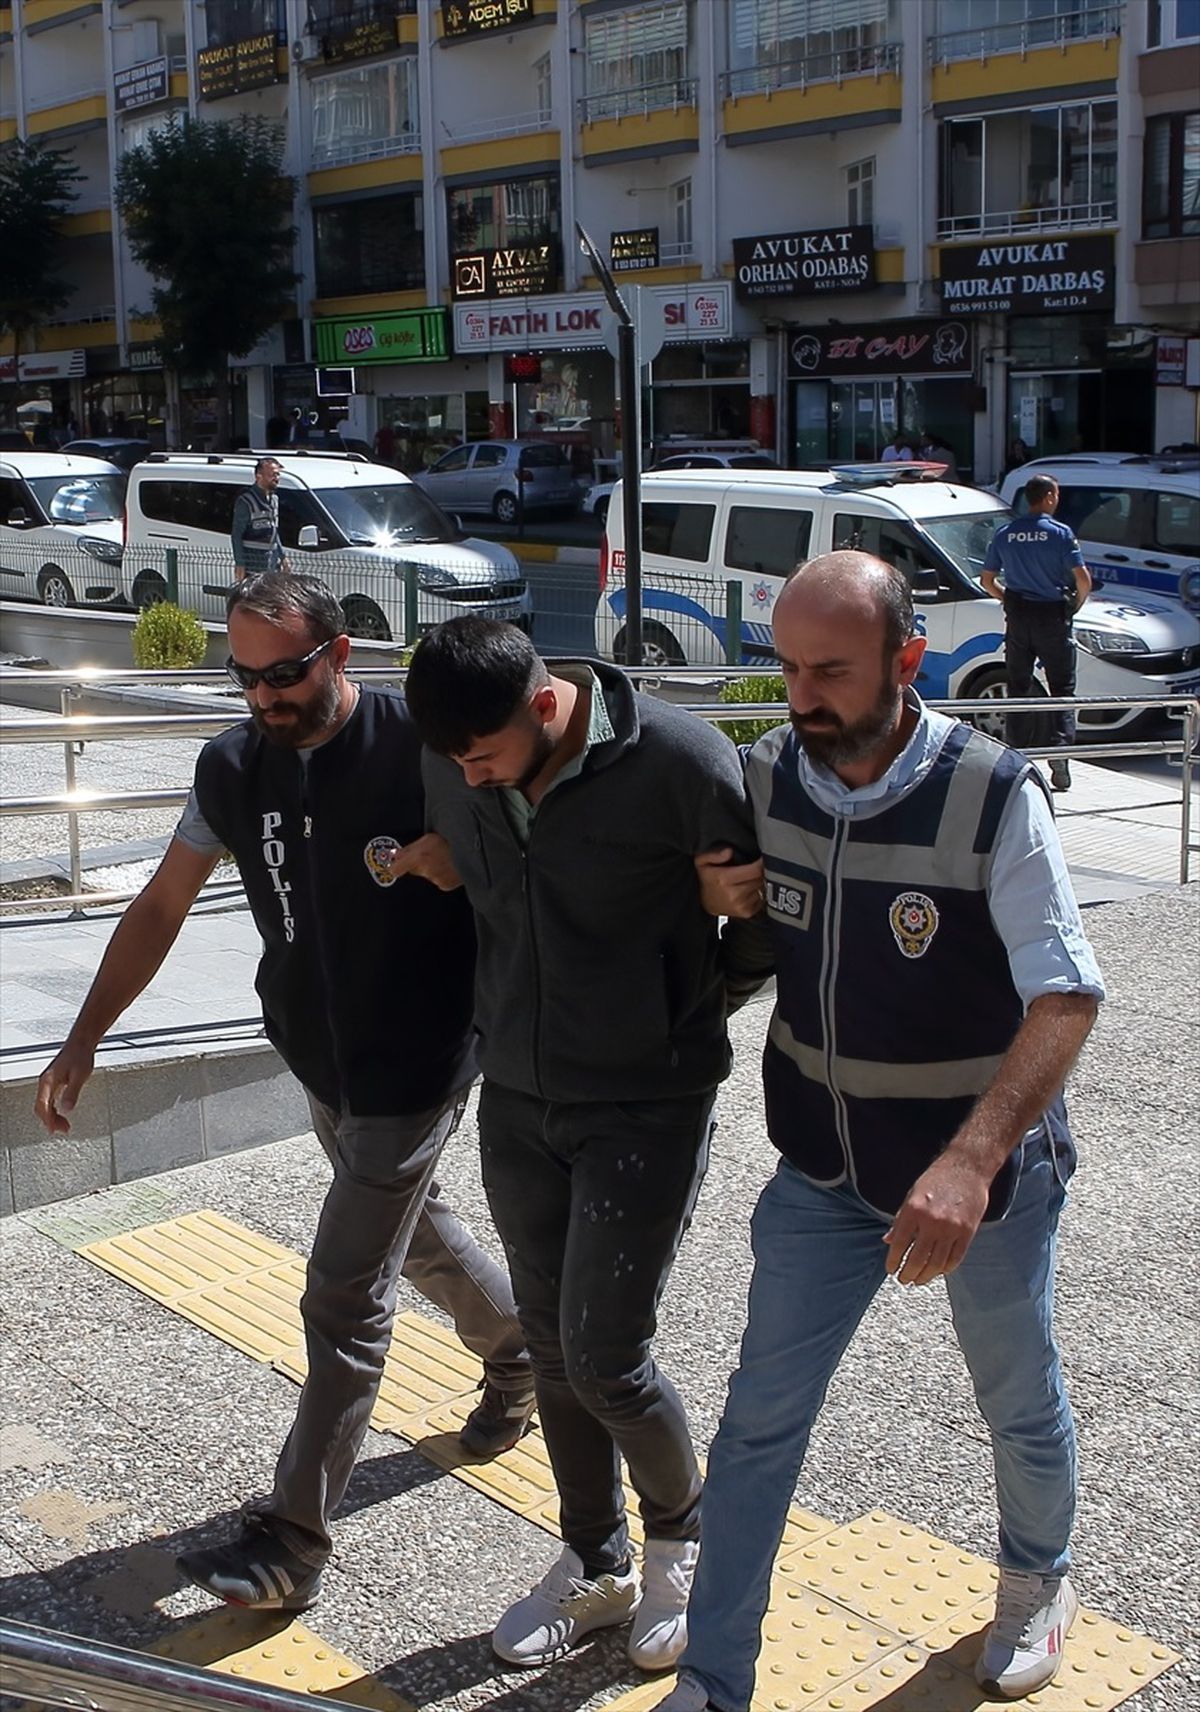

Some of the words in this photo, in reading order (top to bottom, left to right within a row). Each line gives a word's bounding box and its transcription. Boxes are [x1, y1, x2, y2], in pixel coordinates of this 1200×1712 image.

[469, 3, 503, 23] ADEM
[199, 45, 235, 66] AVUKAT
[237, 34, 275, 56] AVUKAT
[492, 245, 549, 270] AYVAZ
[752, 232, 852, 260] AVUKAT
[977, 242, 1069, 267] AVUKAT
[739, 260, 799, 284] ORHAN
[802, 254, 869, 281] ODABAŞ
[943, 276, 1016, 299] MURAT
[1021, 269, 1106, 297] DARBAŞ
[700, 302, 719, 311] 0364
[702, 310, 717, 318] 227
[999, 300, 1011, 310] 00
[489, 309, 548, 337] FATİH
[766, 883, 802, 916] LİS
